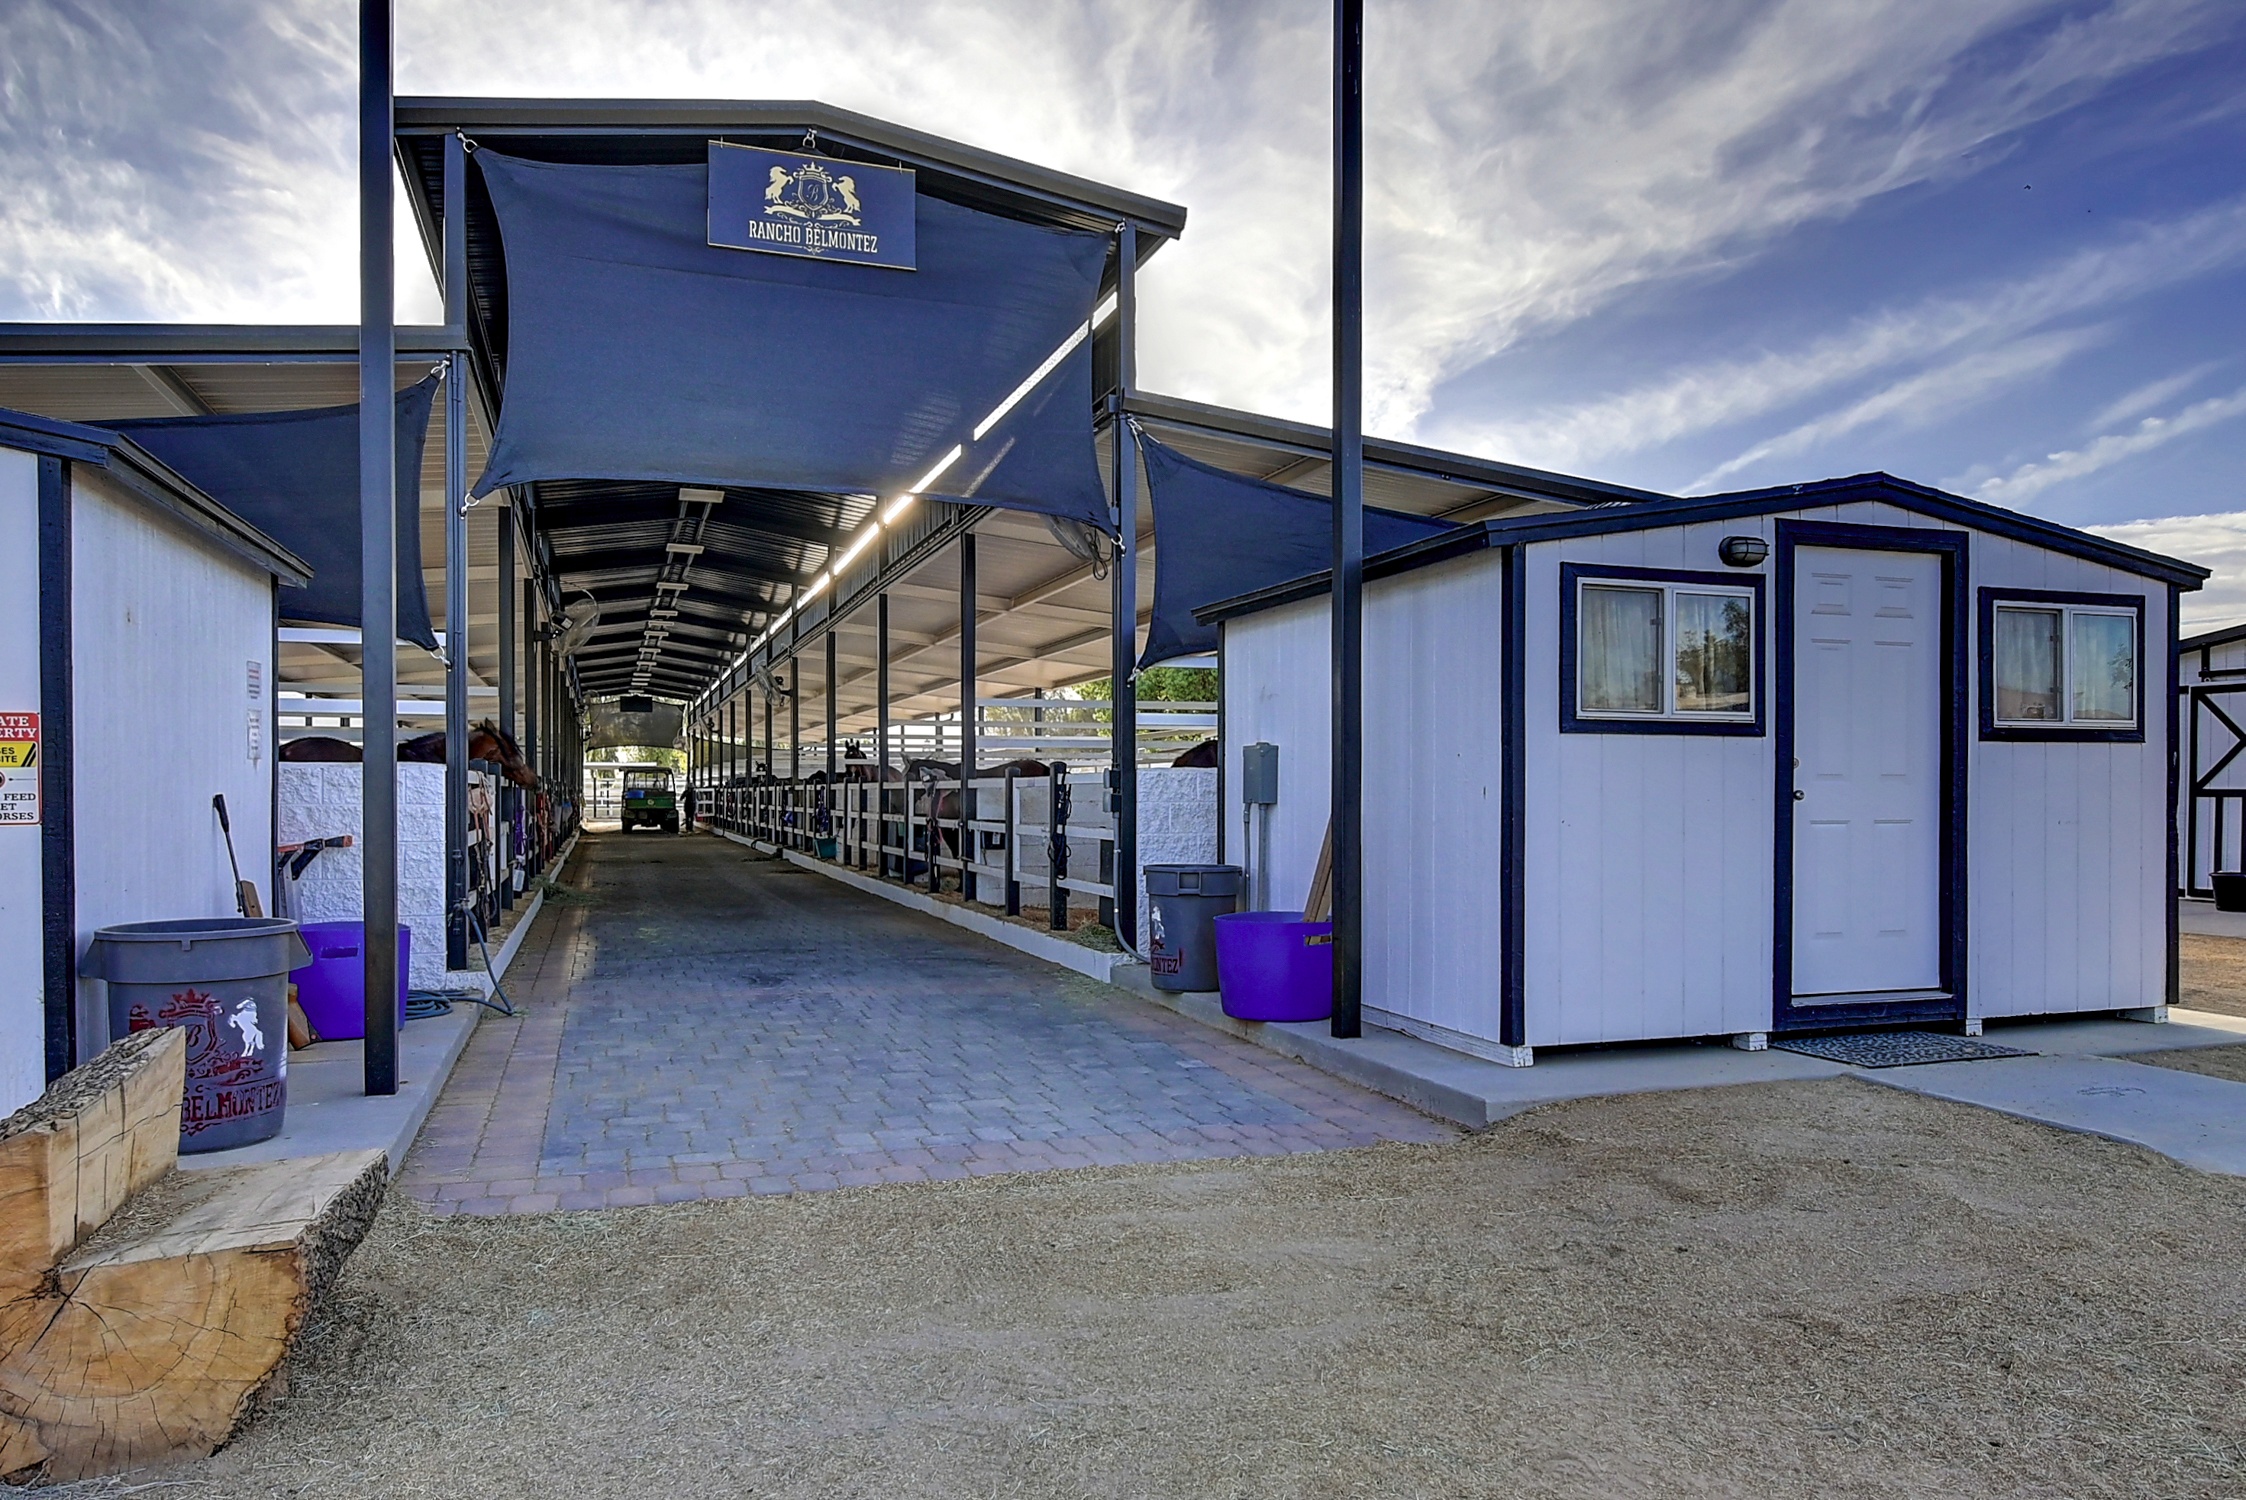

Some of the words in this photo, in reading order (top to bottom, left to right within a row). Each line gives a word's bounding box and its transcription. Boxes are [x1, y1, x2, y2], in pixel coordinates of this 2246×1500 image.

[748, 220, 801, 244] RANCHO
[805, 227, 878, 253] BELMONTEZ
[4, 793, 36, 801] FEED
[0, 812, 34, 821] RSES
[181, 1081, 281, 1122] BELMONTEZ
